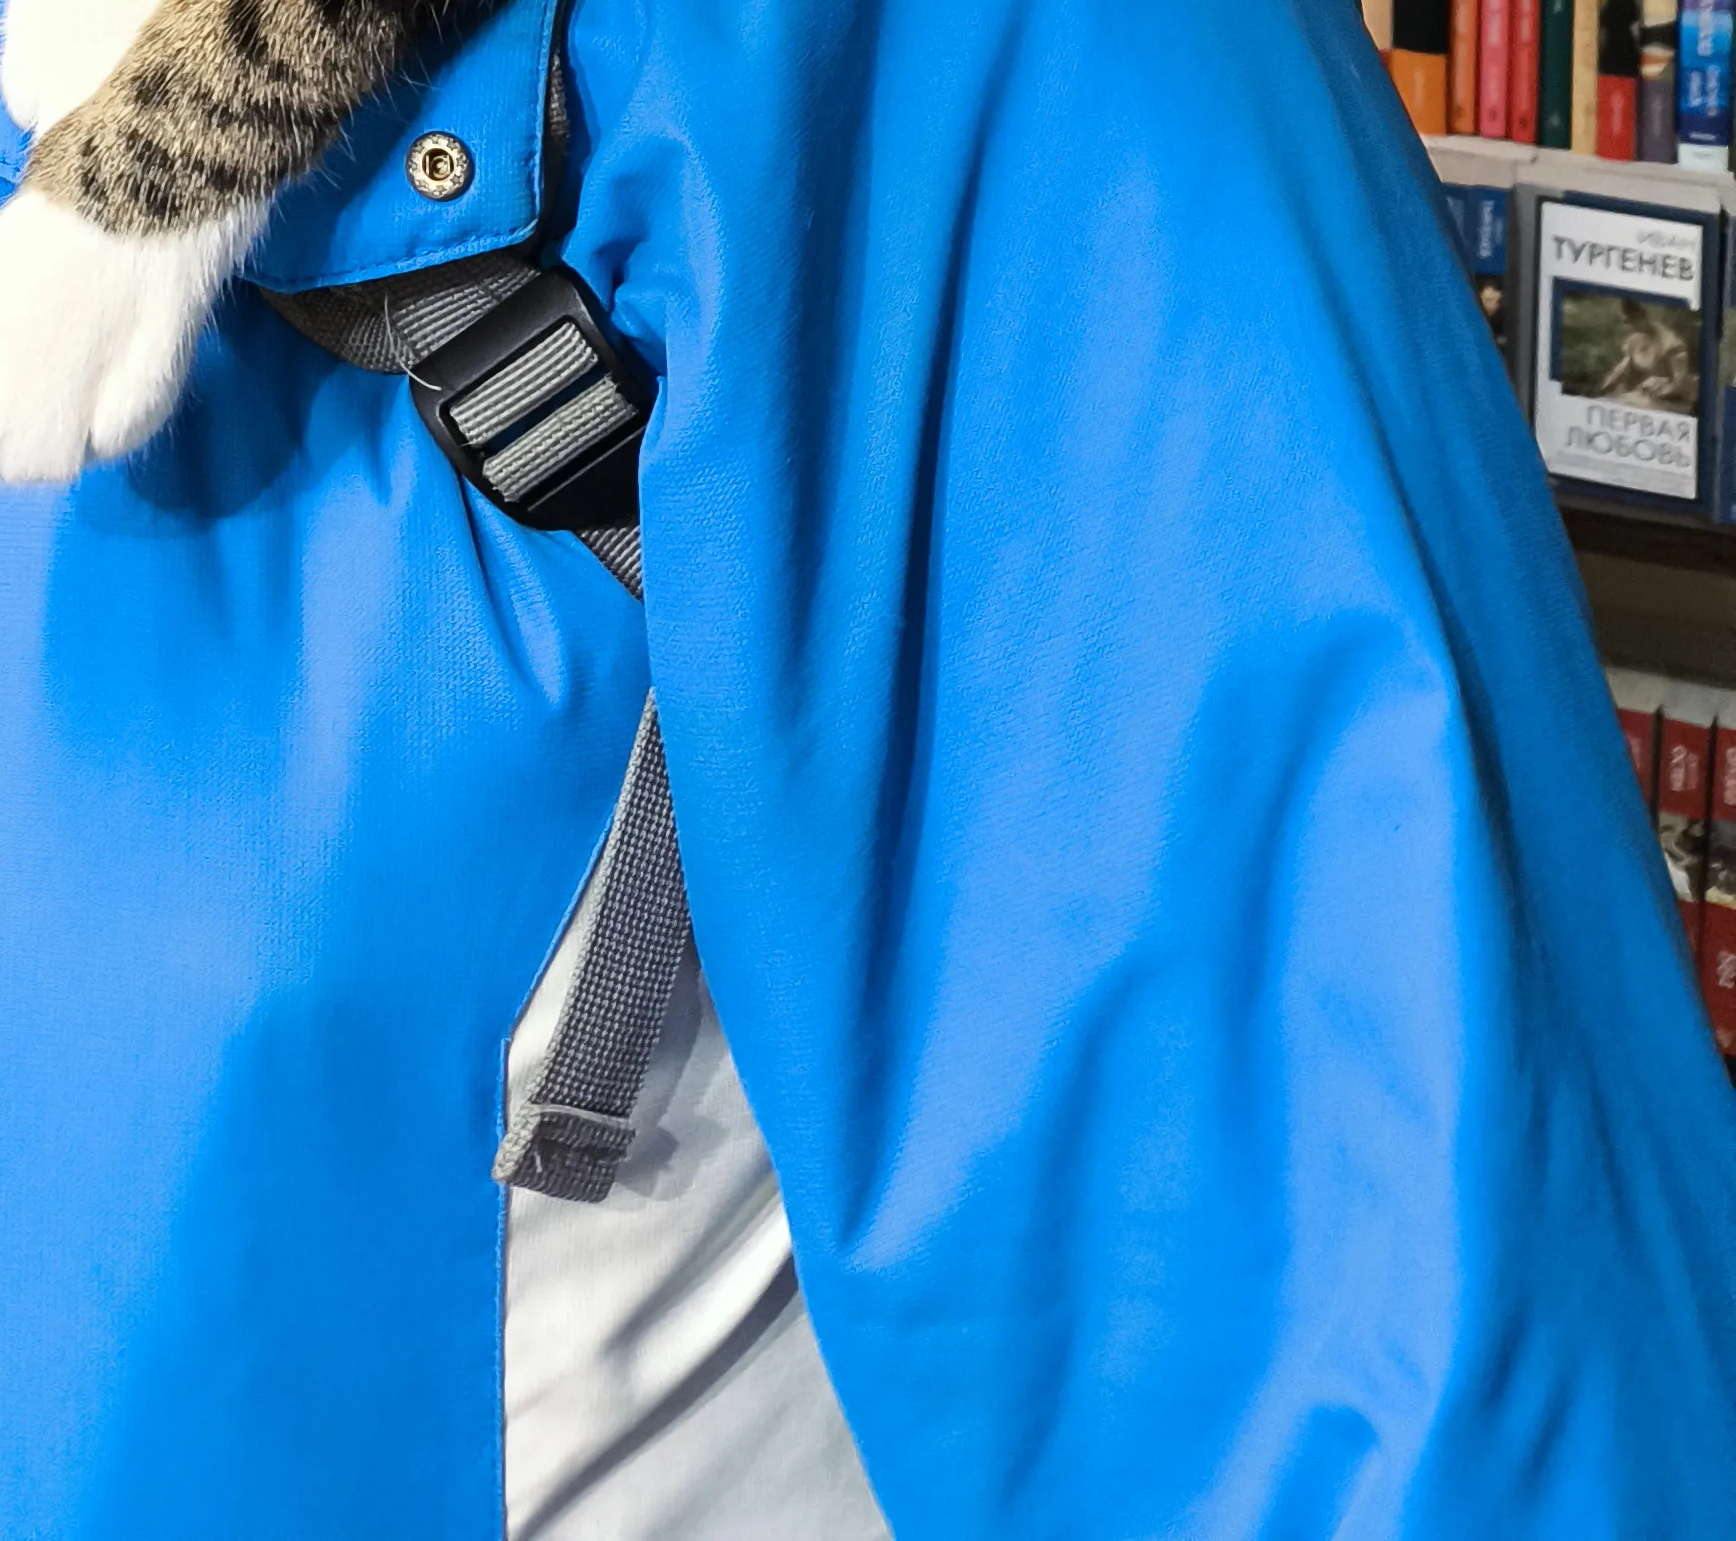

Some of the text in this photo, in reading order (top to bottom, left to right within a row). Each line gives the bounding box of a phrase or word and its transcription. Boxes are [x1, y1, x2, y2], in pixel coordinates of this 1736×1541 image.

[1551, 235, 1695, 283] ТУРГЕНЕВ
[1586, 405, 1692, 442] ПЕРВАЯ
[1566, 428, 1692, 469] ЛЮБОВЬ
